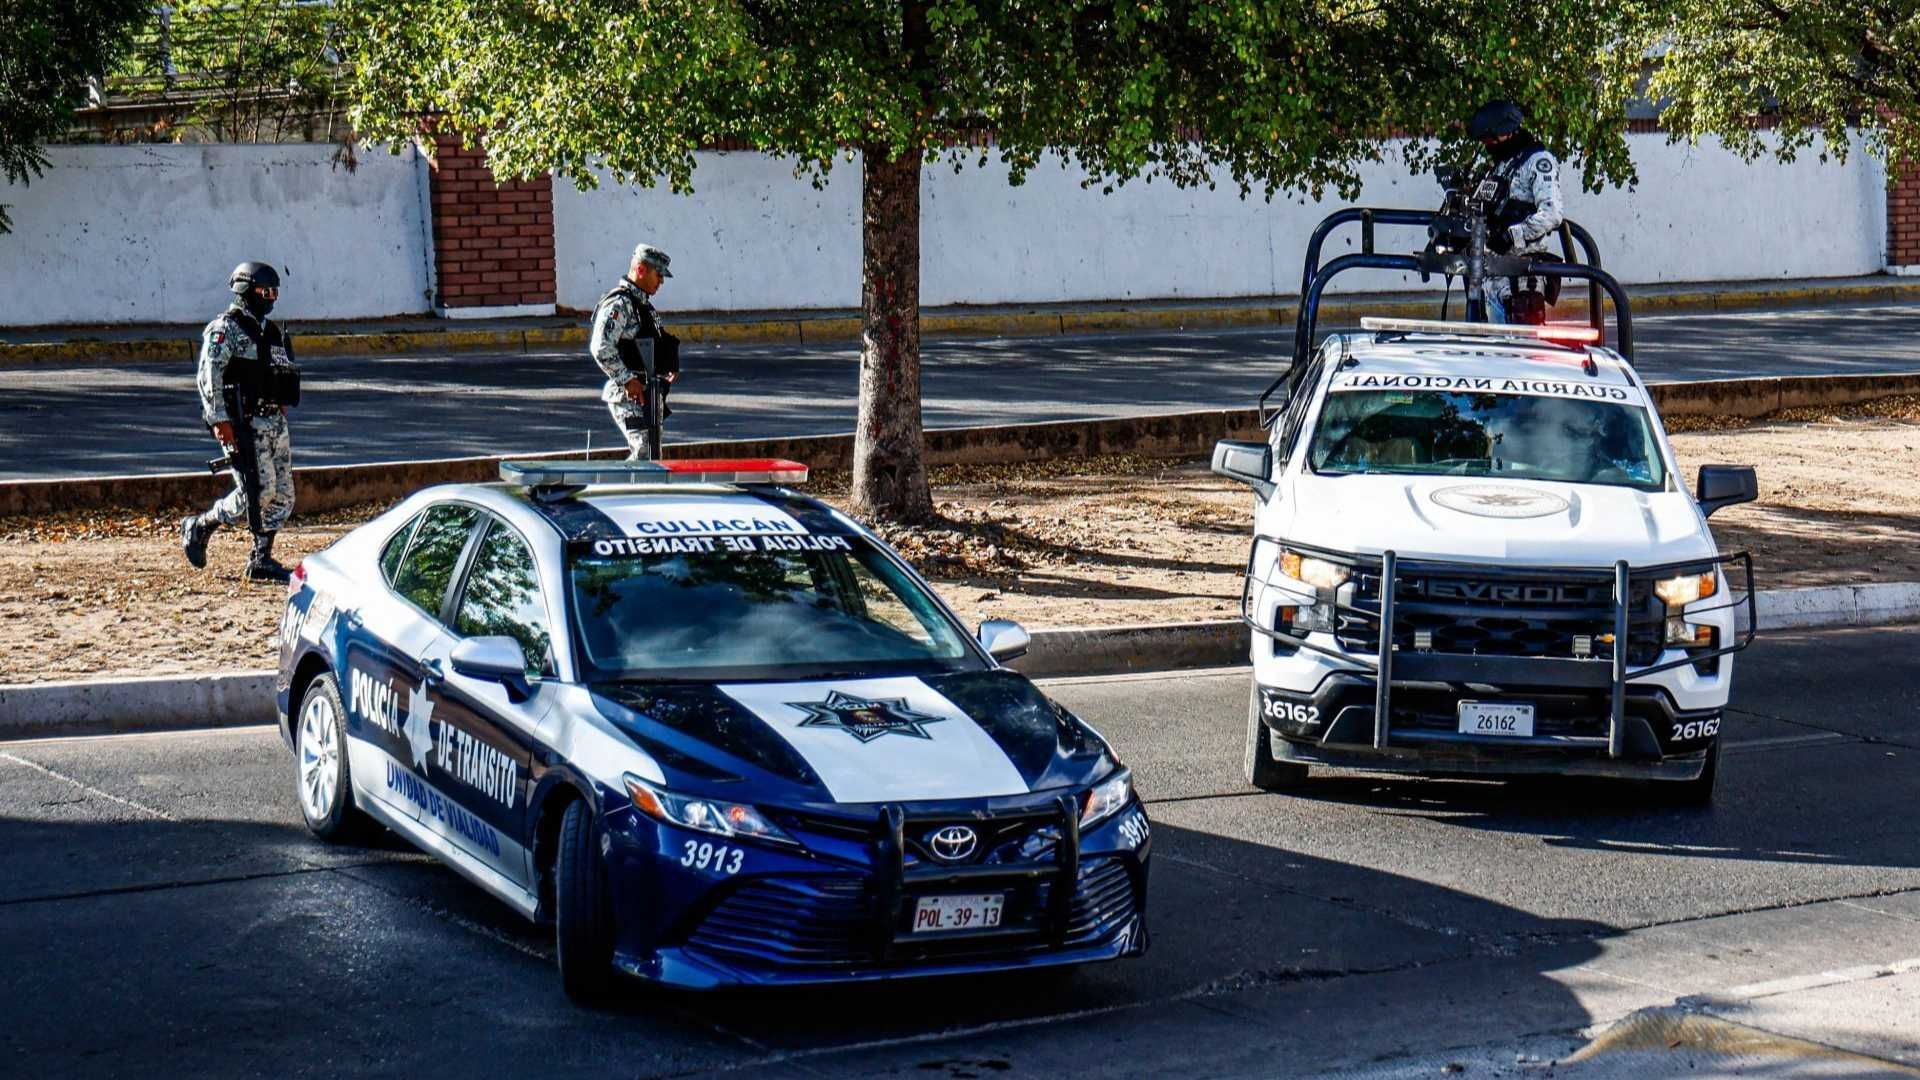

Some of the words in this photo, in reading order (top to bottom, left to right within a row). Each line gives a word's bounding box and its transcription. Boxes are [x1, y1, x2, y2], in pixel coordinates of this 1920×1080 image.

[1264, 697, 1321, 724] 26162
[1477, 714, 1516, 731] 26162
[350, 667, 400, 738] POLICÍA
[438, 719, 455, 773] DE
[456, 729, 517, 809] TRANSITO
[1671, 717, 1721, 741] 26162
[386, 760, 428, 810] UNIDAD
[428, 789, 446, 823] DE
[444, 799, 500, 858] VIALIDAD
[1118, 811, 1150, 849] 3913
[680, 839, 745, 875] 3913
[917, 907, 1000, 928] POL-39-13
